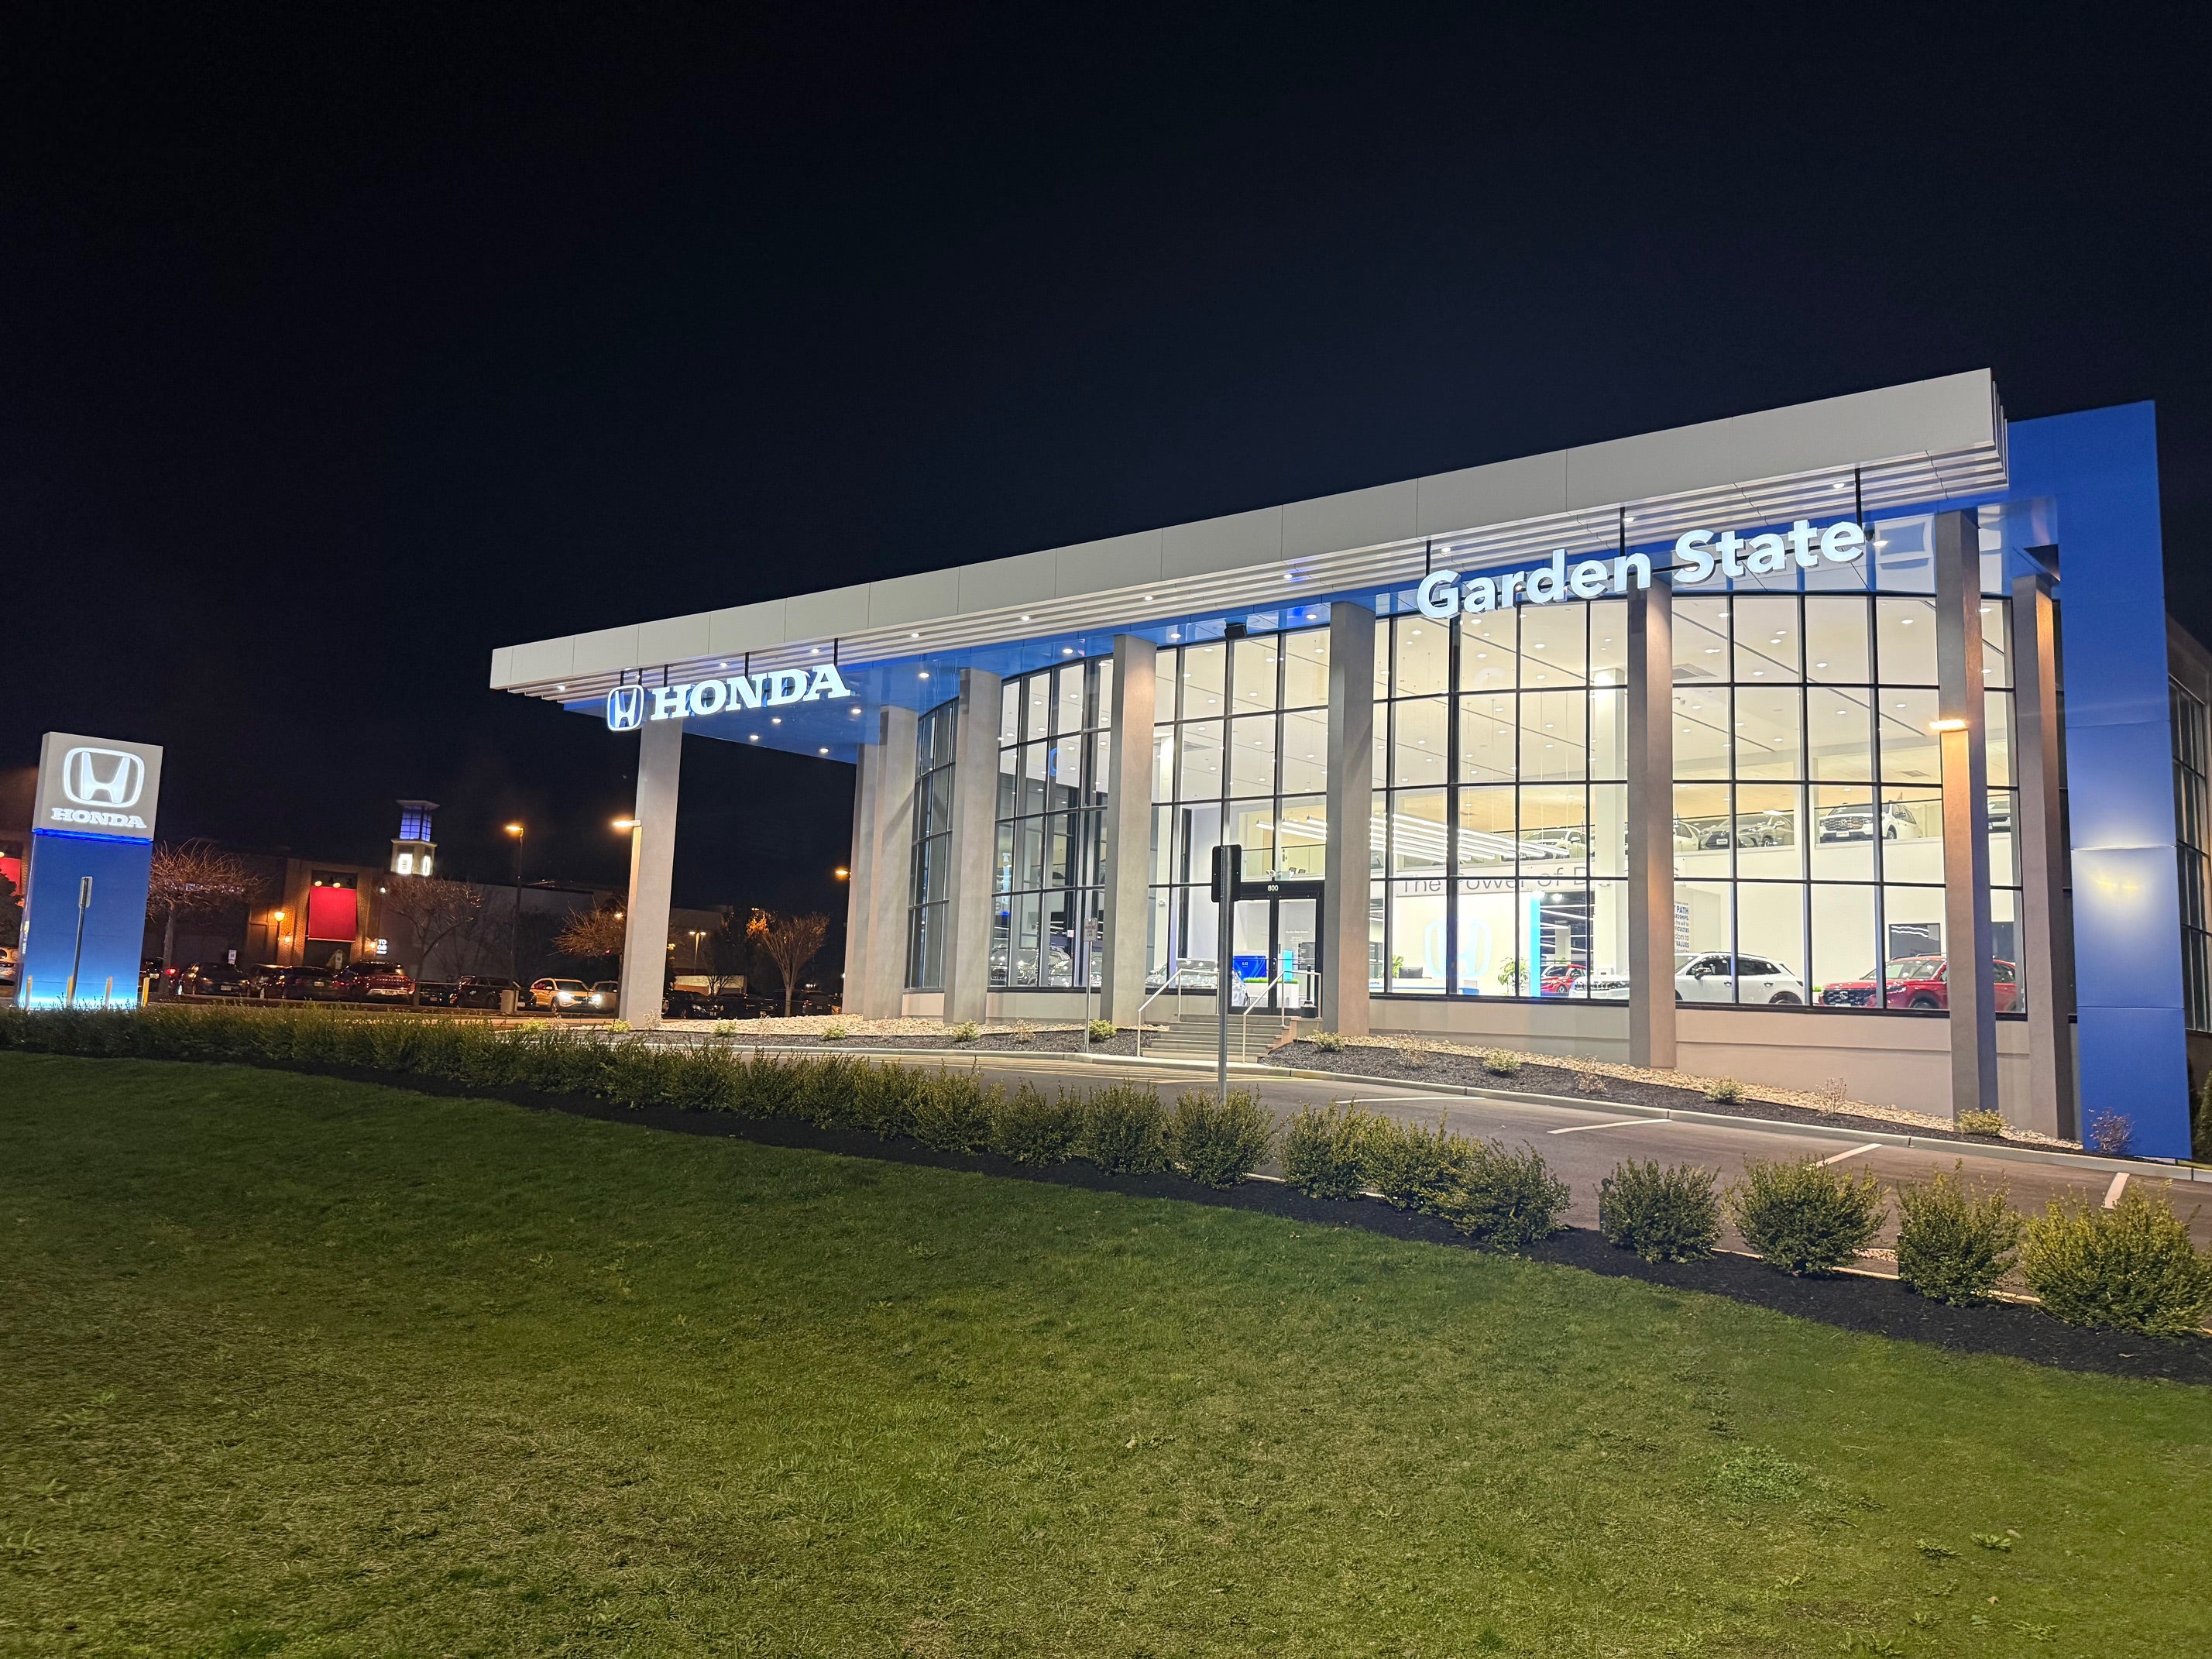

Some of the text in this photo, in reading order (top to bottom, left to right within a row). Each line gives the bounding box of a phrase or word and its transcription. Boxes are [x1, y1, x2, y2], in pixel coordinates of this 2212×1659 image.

[1417, 519, 1866, 619] Garden State
[651, 663, 851, 721] HONDA
[50, 807, 147, 829] HONDA
[1537, 867, 1564, 887] of
[1677, 905, 1688, 915] PATH
